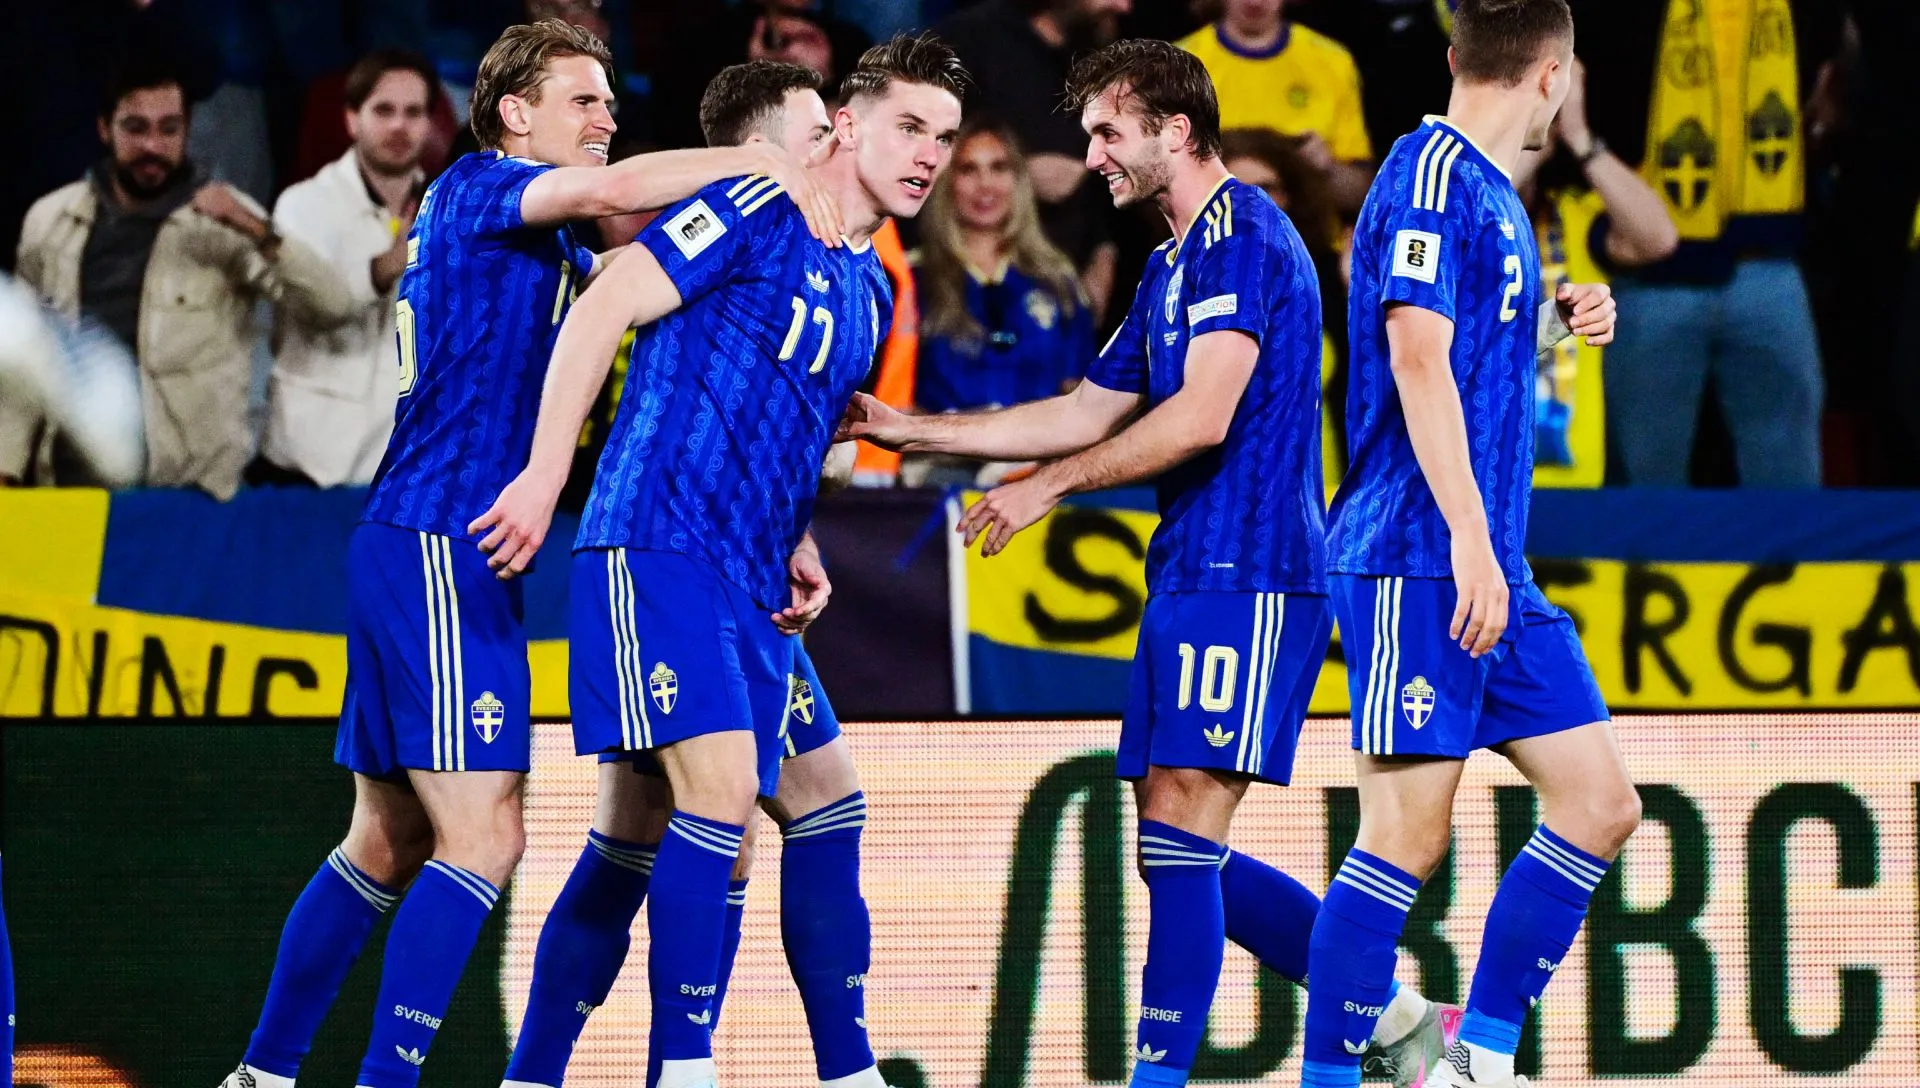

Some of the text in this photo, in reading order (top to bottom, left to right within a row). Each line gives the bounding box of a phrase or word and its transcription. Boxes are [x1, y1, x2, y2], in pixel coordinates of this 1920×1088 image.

[1500, 254, 1523, 323] 2
[777, 295, 834, 375] 17
[1178, 643, 1239, 713] 10
[394, 1004, 443, 1031] SVERIG
[1141, 1005, 1183, 1023] ERIGE
